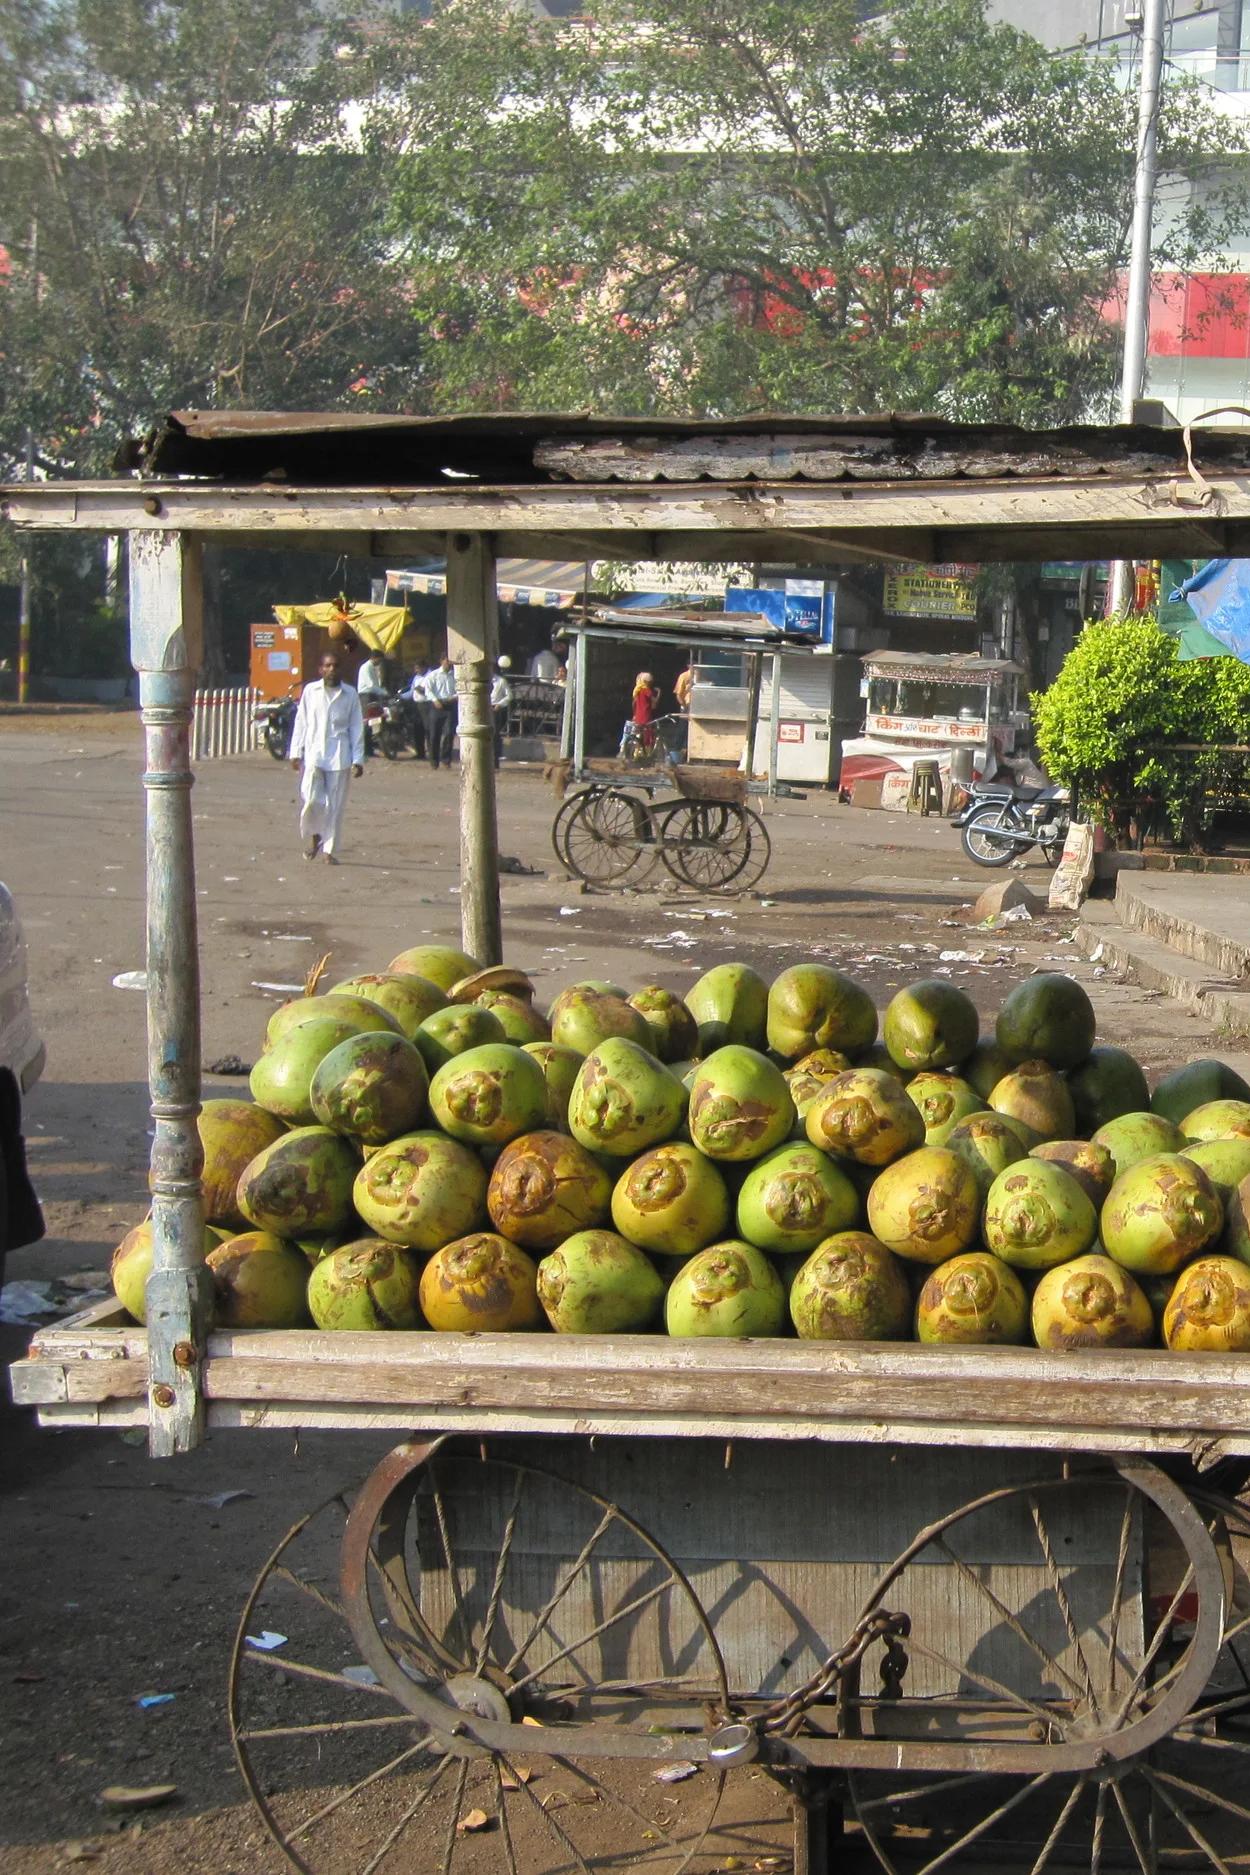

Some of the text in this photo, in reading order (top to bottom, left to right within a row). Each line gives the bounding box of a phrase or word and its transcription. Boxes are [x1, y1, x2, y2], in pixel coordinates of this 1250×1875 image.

[888, 575, 898, 609] XEROX
[903, 600, 956, 610] COURIER
[918, 723, 940, 734] चाट
